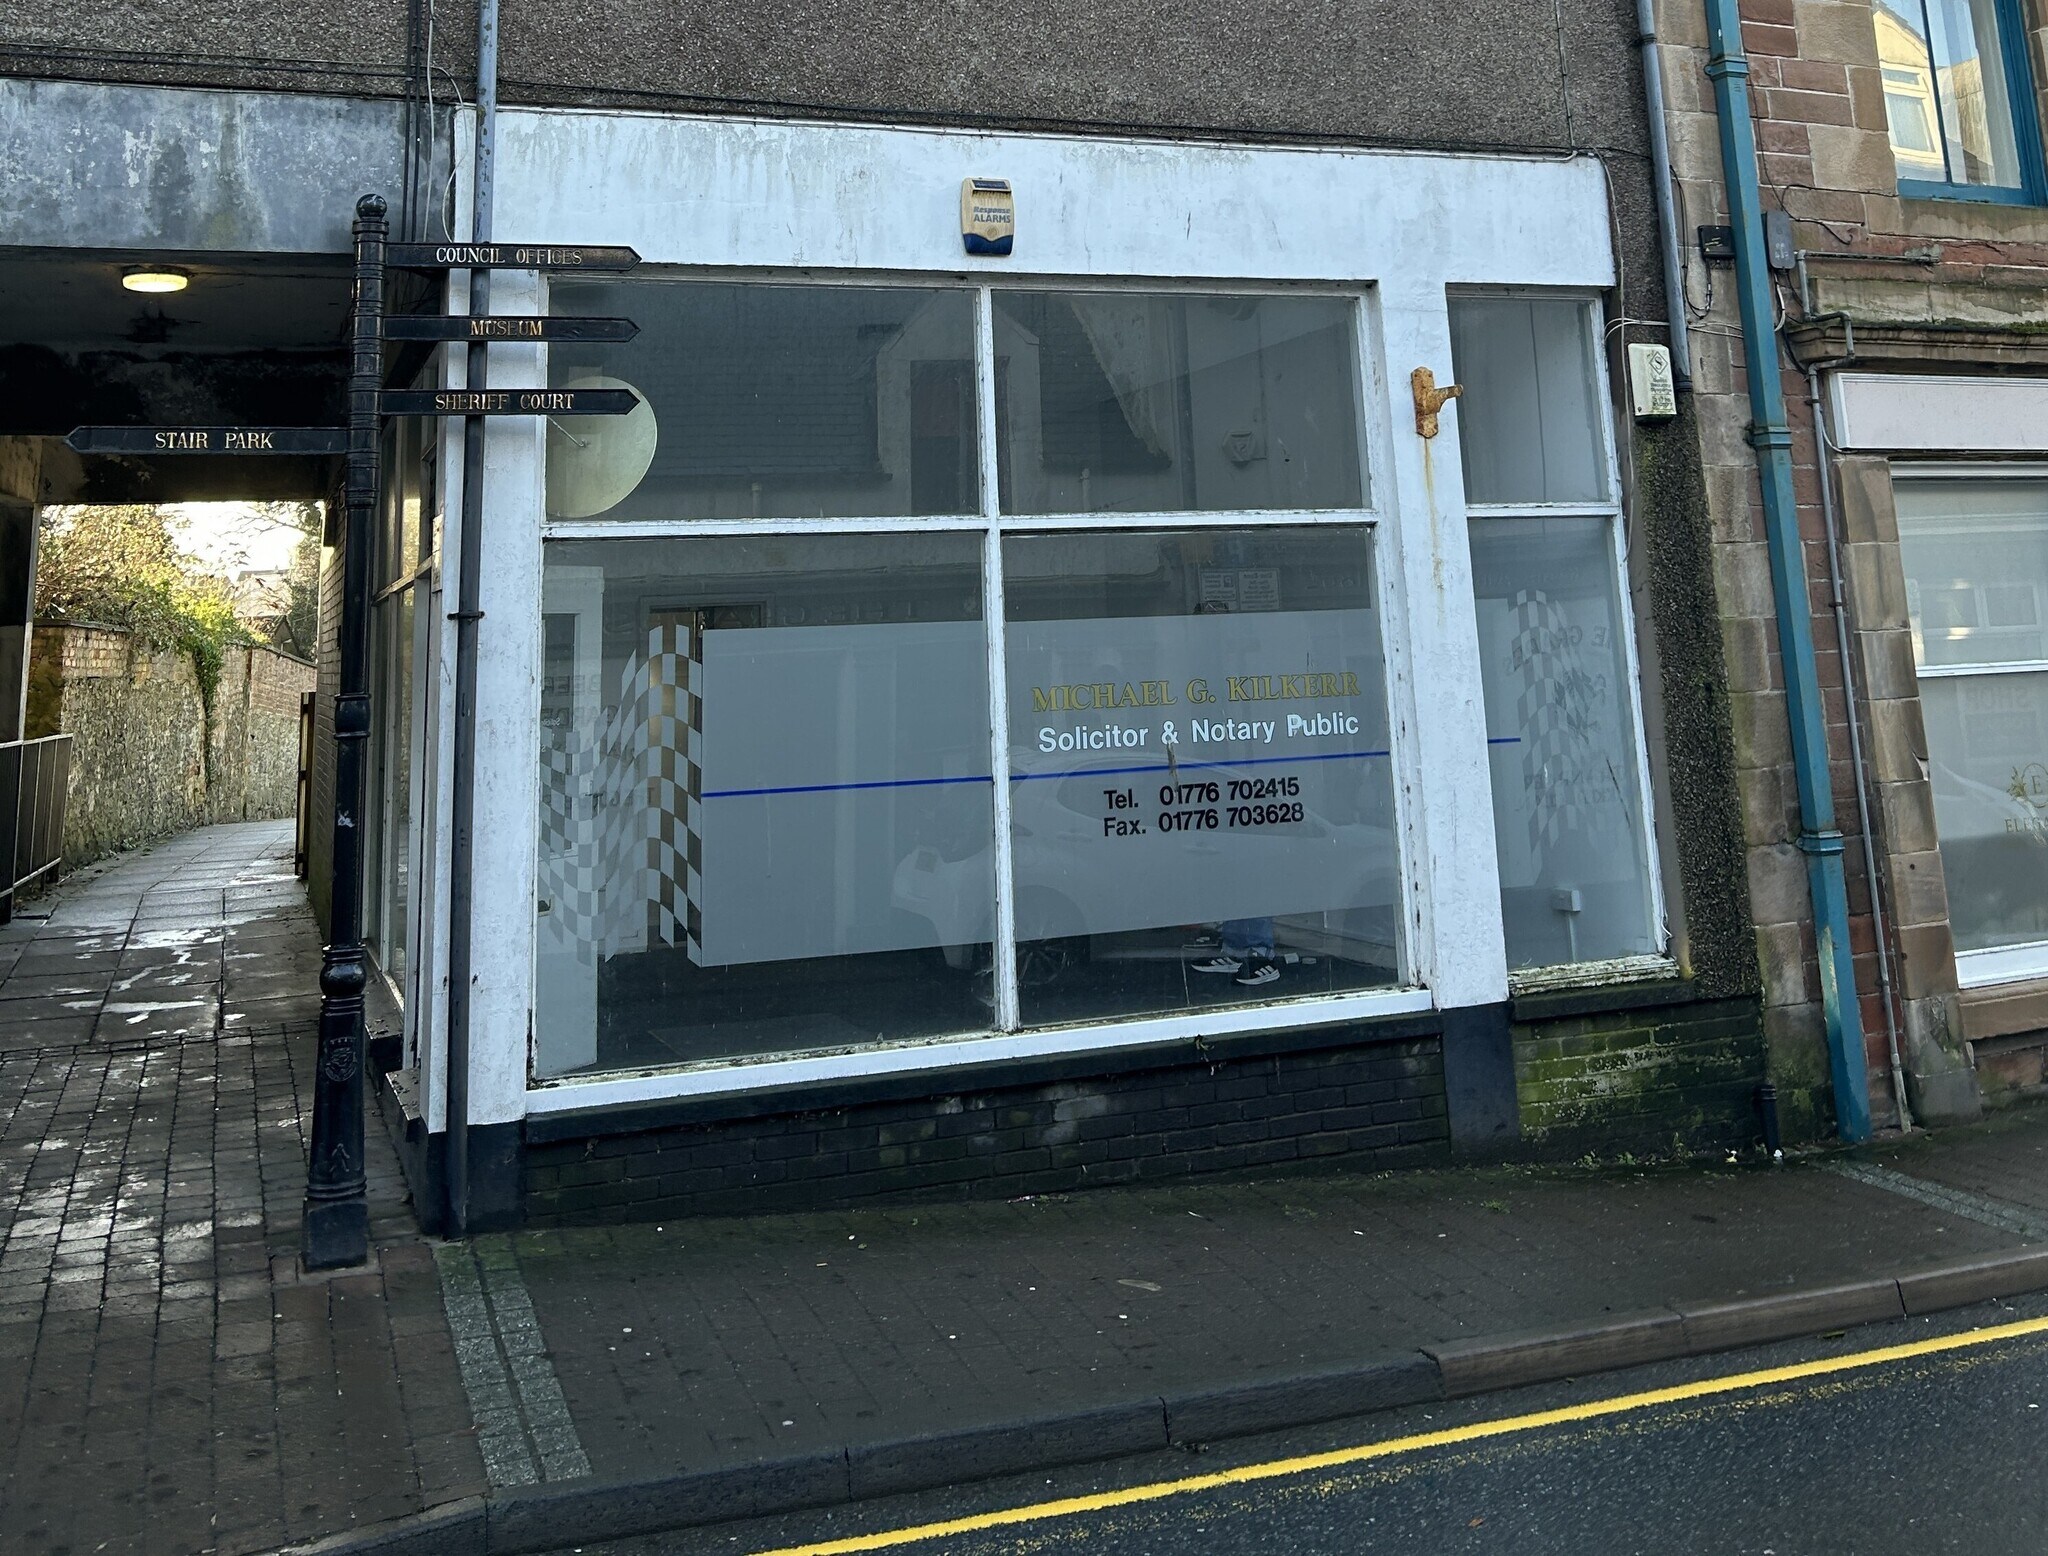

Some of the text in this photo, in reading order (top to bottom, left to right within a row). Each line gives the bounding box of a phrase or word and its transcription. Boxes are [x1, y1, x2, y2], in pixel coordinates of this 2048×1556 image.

[973, 214, 1011, 223] ALARMS
[436, 247, 582, 265] COUNCIL OFFICES
[471, 320, 543, 336] MUSEUM
[435, 393, 574, 410] SHERIFF COURT
[155, 432, 274, 449] STAIR PARK
[1031, 671, 1362, 713] MICHAEL G. KILKERR
[1038, 712, 1360, 753] Solicitor & Notary Public
[1103, 777, 1300, 810] Tel. 01776 702415
[1103, 802, 1304, 837] Fax. 01776 703628
